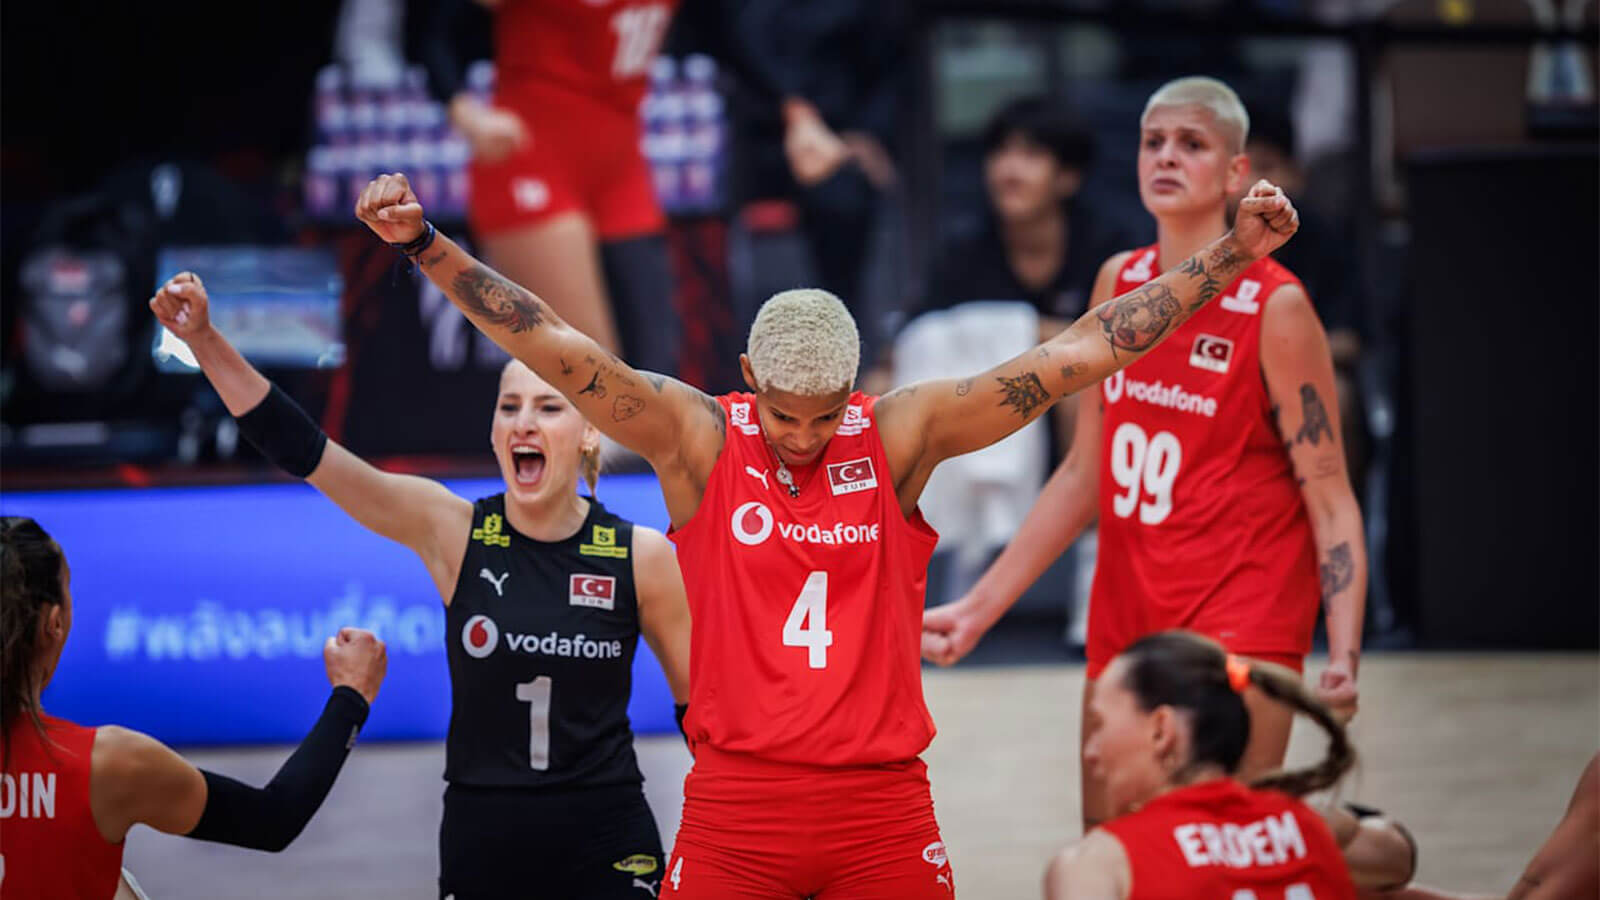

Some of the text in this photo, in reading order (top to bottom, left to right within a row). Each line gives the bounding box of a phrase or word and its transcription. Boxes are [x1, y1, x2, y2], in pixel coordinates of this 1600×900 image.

[1125, 379, 1218, 418] vodafone
[1111, 422, 1182, 526] 99
[778, 522, 879, 545] vodafone
[782, 571, 833, 669] 4
[505, 632, 622, 659] vodafone
[516, 676, 552, 770] 1
[0, 772, 57, 819] DIN
[1173, 811, 1307, 868] ERDEM
[670, 856, 684, 890] 4
